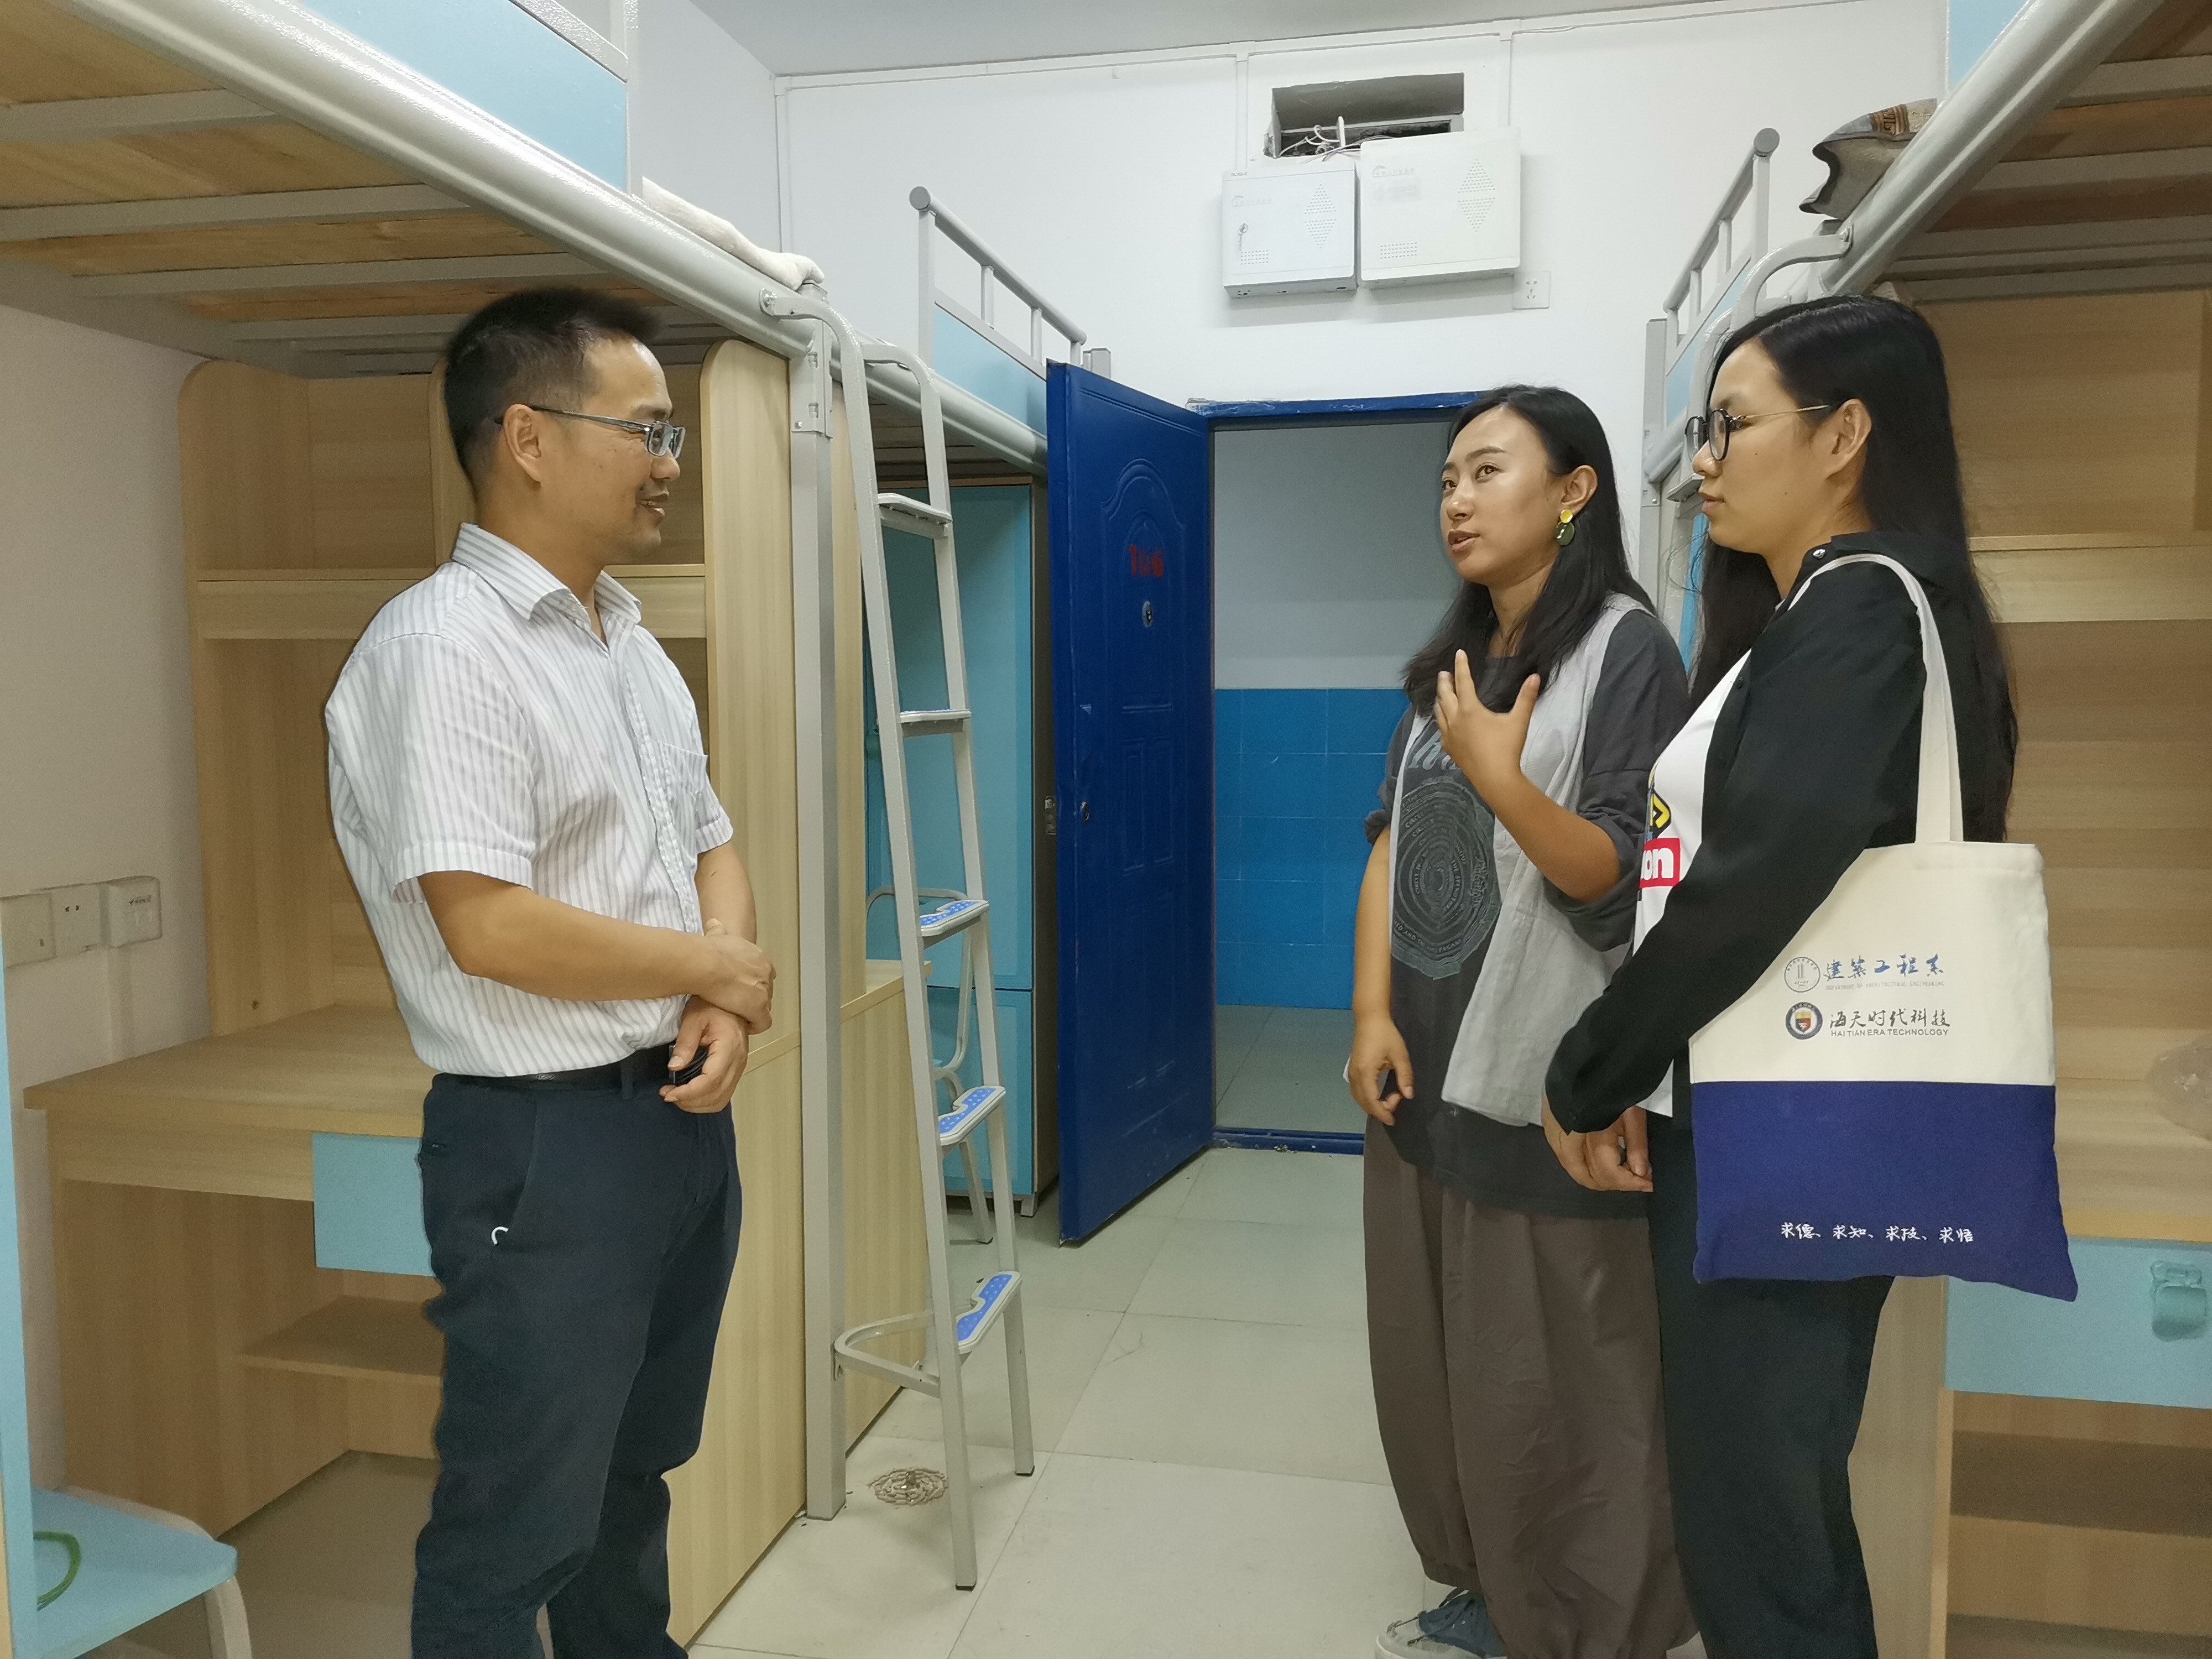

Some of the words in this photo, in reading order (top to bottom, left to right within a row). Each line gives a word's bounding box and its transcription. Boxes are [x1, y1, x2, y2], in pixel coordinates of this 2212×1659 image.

[1830, 1008, 1950, 1028] 海天时代科技
